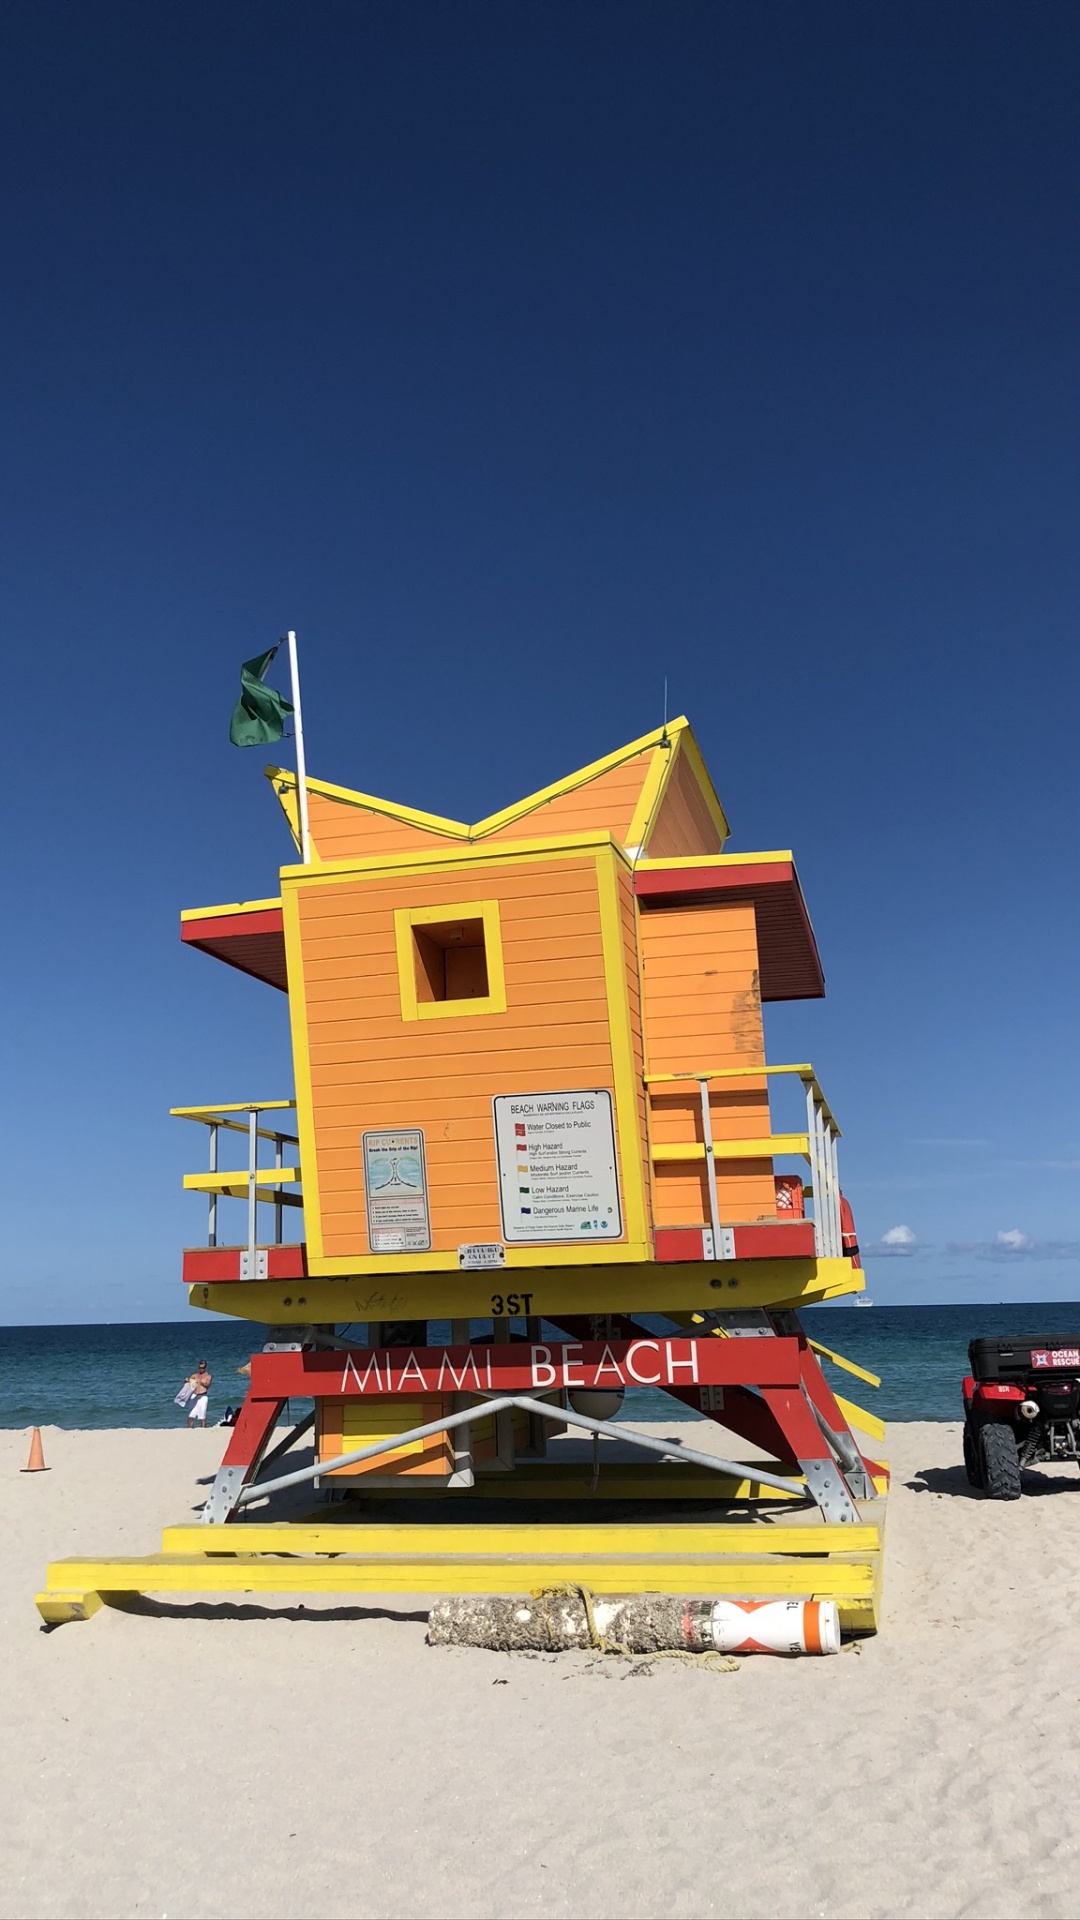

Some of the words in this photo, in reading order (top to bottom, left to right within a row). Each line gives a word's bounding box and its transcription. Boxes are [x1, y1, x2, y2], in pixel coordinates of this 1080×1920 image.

[510, 1104, 534, 1114] BEACH
[537, 1102, 569, 1112] WARNING
[573, 1100, 595, 1110] FLAGS
[545, 1122, 565, 1130] Closed
[574, 1120, 591, 1128] Public
[529, 1144, 541, 1152] High
[546, 1185, 569, 1193] Hazard
[533, 1207, 565, 1215] Dangerous
[490, 1293, 533, 1316] 3ST
[1052, 1350, 1079, 1358] OCEAN
[1053, 1357, 1080, 1365] RESCUE
[340, 1348, 493, 1393] MIAMI
[530, 1340, 699, 1388] BEACH
